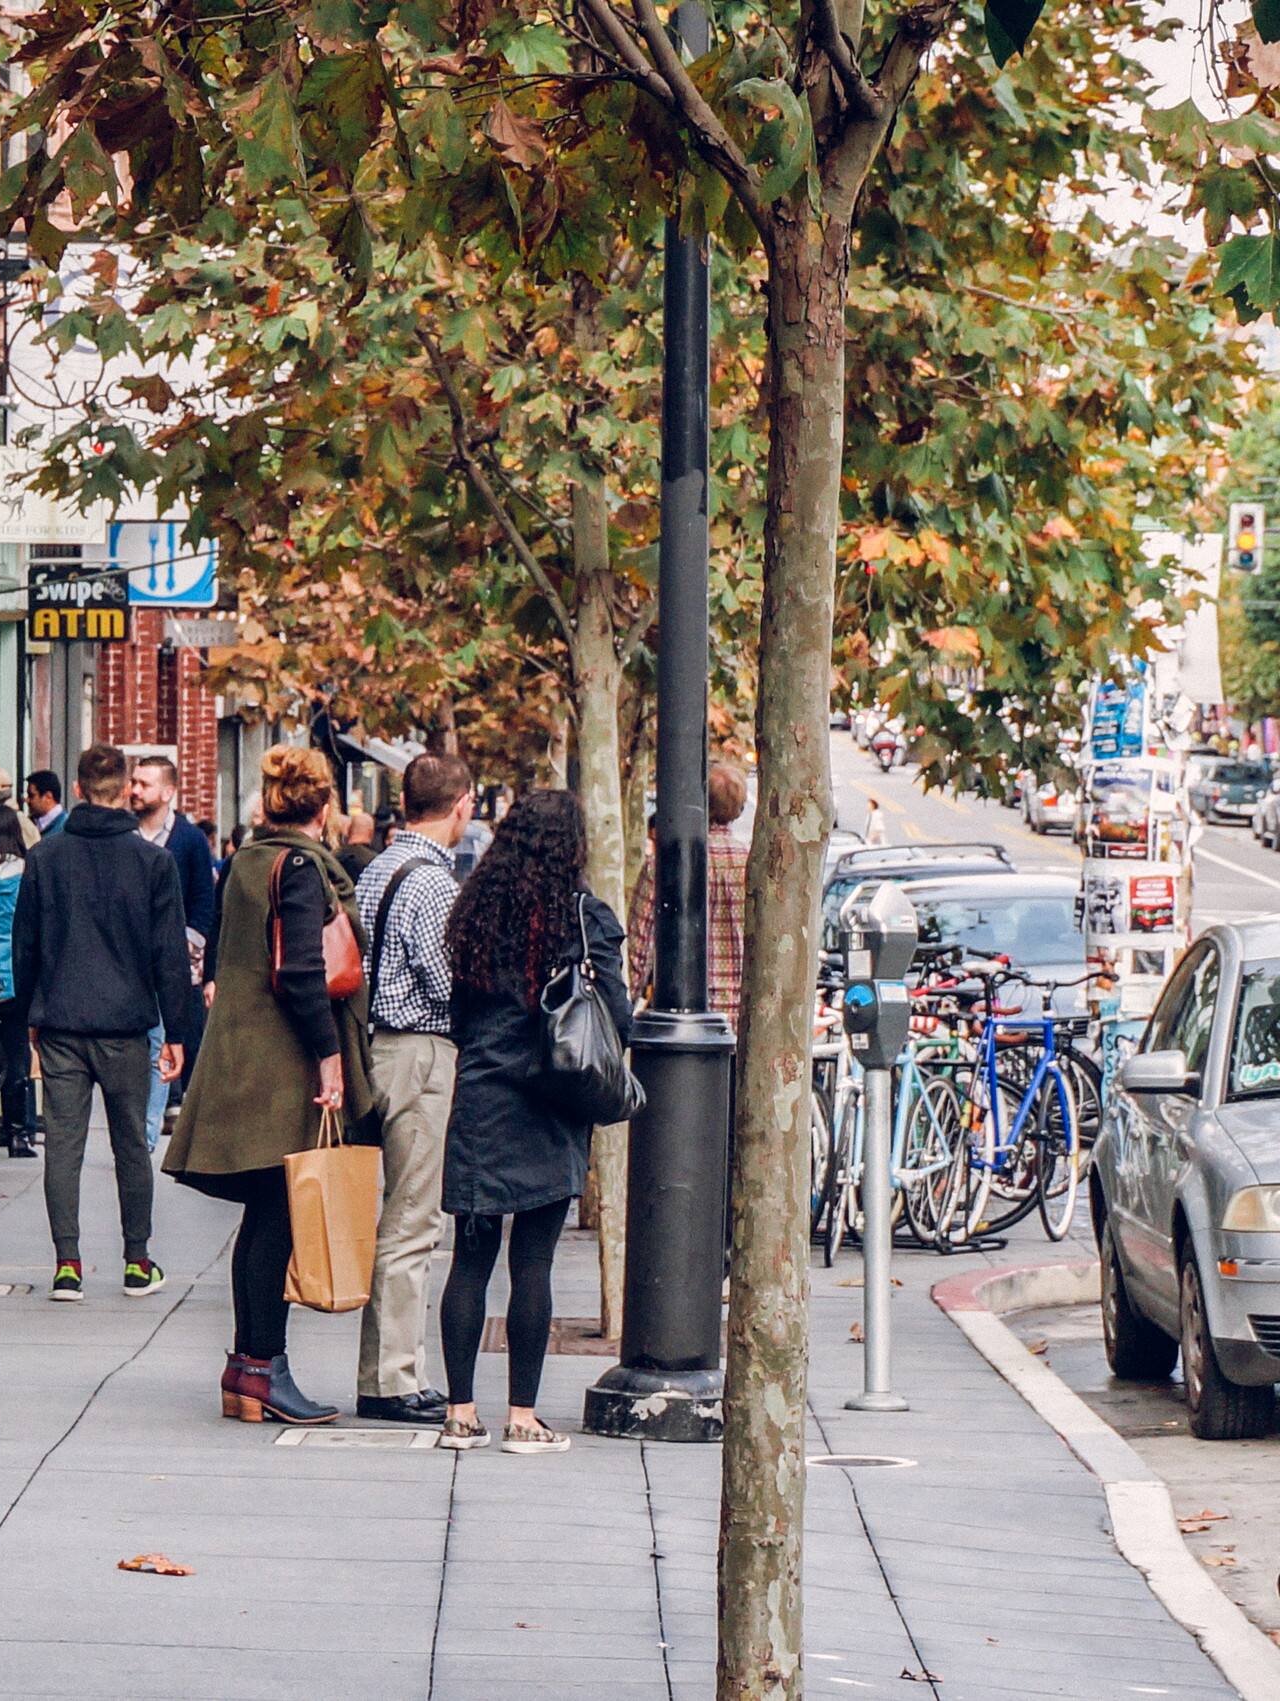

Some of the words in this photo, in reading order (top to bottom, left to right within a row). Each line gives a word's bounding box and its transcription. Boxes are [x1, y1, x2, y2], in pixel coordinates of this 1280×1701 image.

[25, 525, 49, 536] FOR
[57, 525, 84, 537] KIDS
[36, 573, 104, 608] Swipe
[33, 608, 125, 639] ATM
